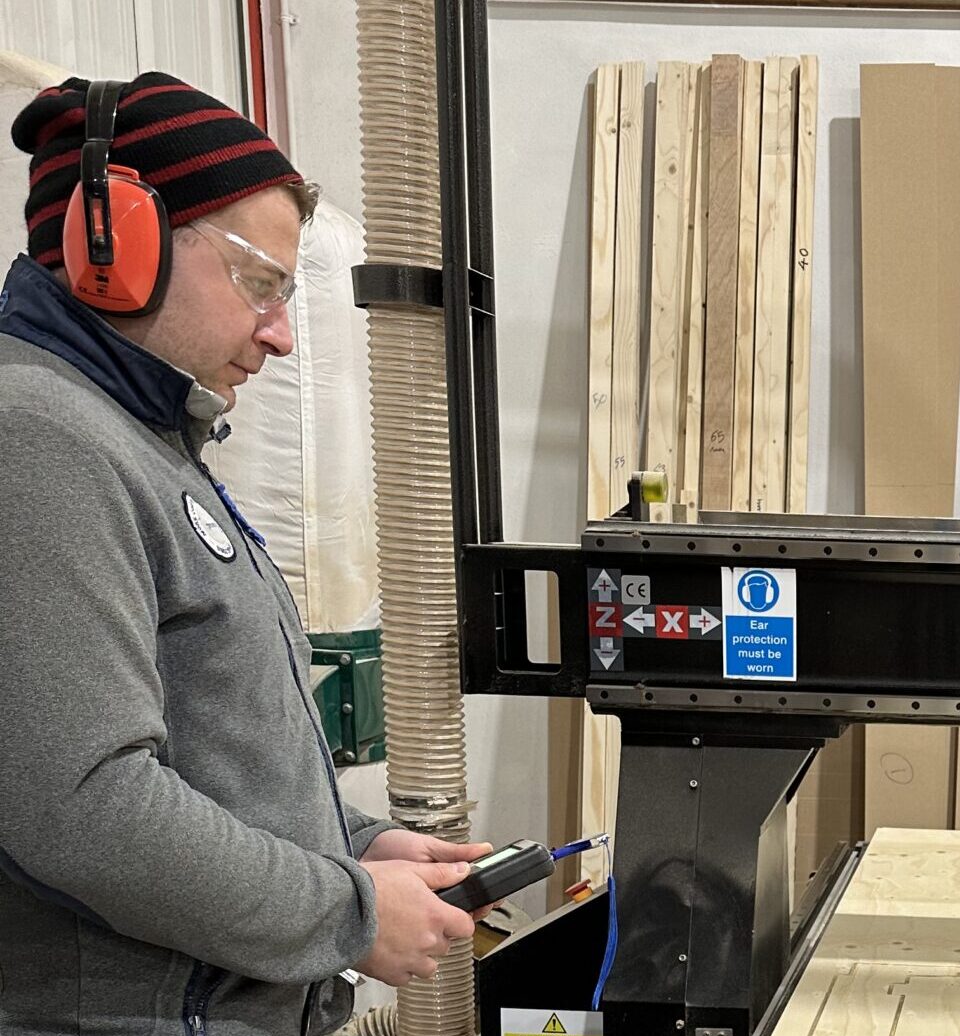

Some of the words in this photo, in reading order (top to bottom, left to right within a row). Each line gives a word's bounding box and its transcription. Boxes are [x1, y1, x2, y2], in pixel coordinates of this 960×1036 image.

[626, 582, 645, 598] CE
[595, 606, 616, 628] Z
[661, 611, 684, 633] X
[750, 620, 768, 630] Ear
[732, 635, 787, 646] protection
[738, 650, 765, 659] must
[768, 650, 781, 659] be
[747, 664, 774, 673] worn
